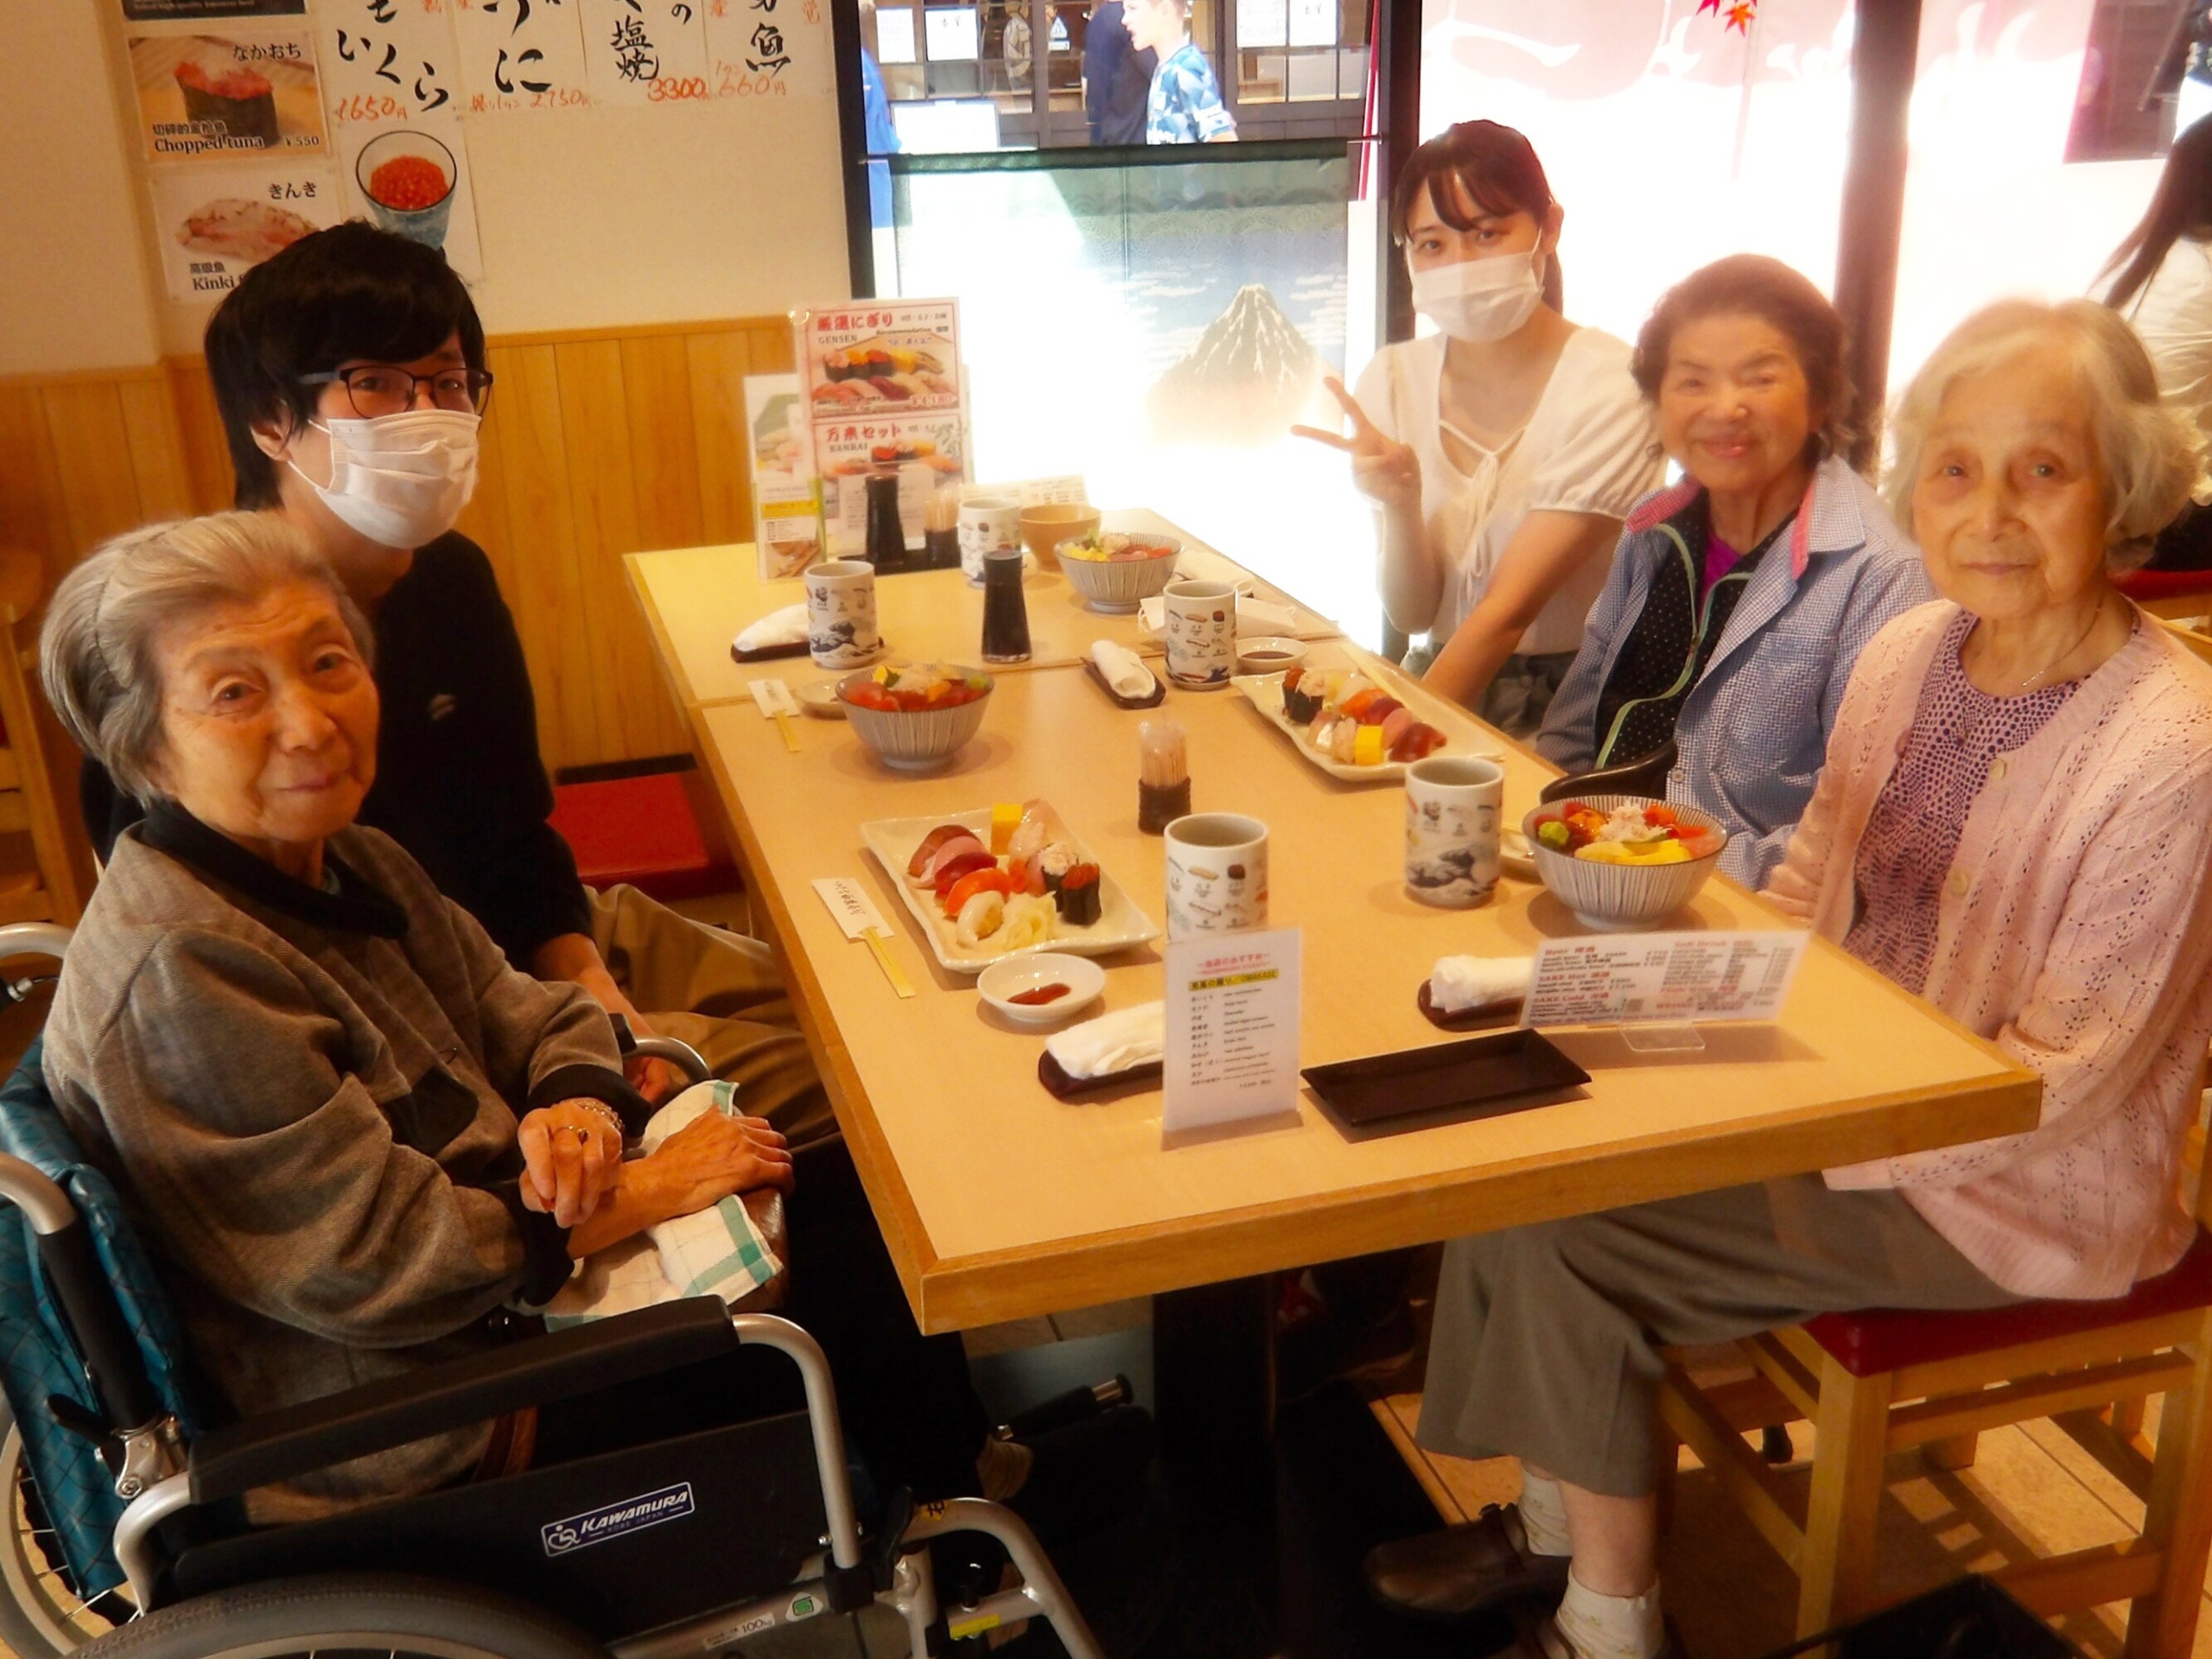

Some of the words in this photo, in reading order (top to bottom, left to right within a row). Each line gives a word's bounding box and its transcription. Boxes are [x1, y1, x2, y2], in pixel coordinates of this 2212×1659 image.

[232, 43, 302, 61] なかおち
[336, 29, 448, 111] いくら
[155, 135, 223, 154] Chopped
[223, 135, 264, 149] tuna
[268, 181, 317, 200] きんき
[193, 275, 234, 290] Kinki
[818, 334, 857, 345] GENSEN
[829, 442, 868, 453] BANRAI
[581, 1491, 688, 1535] KAWAMURA
